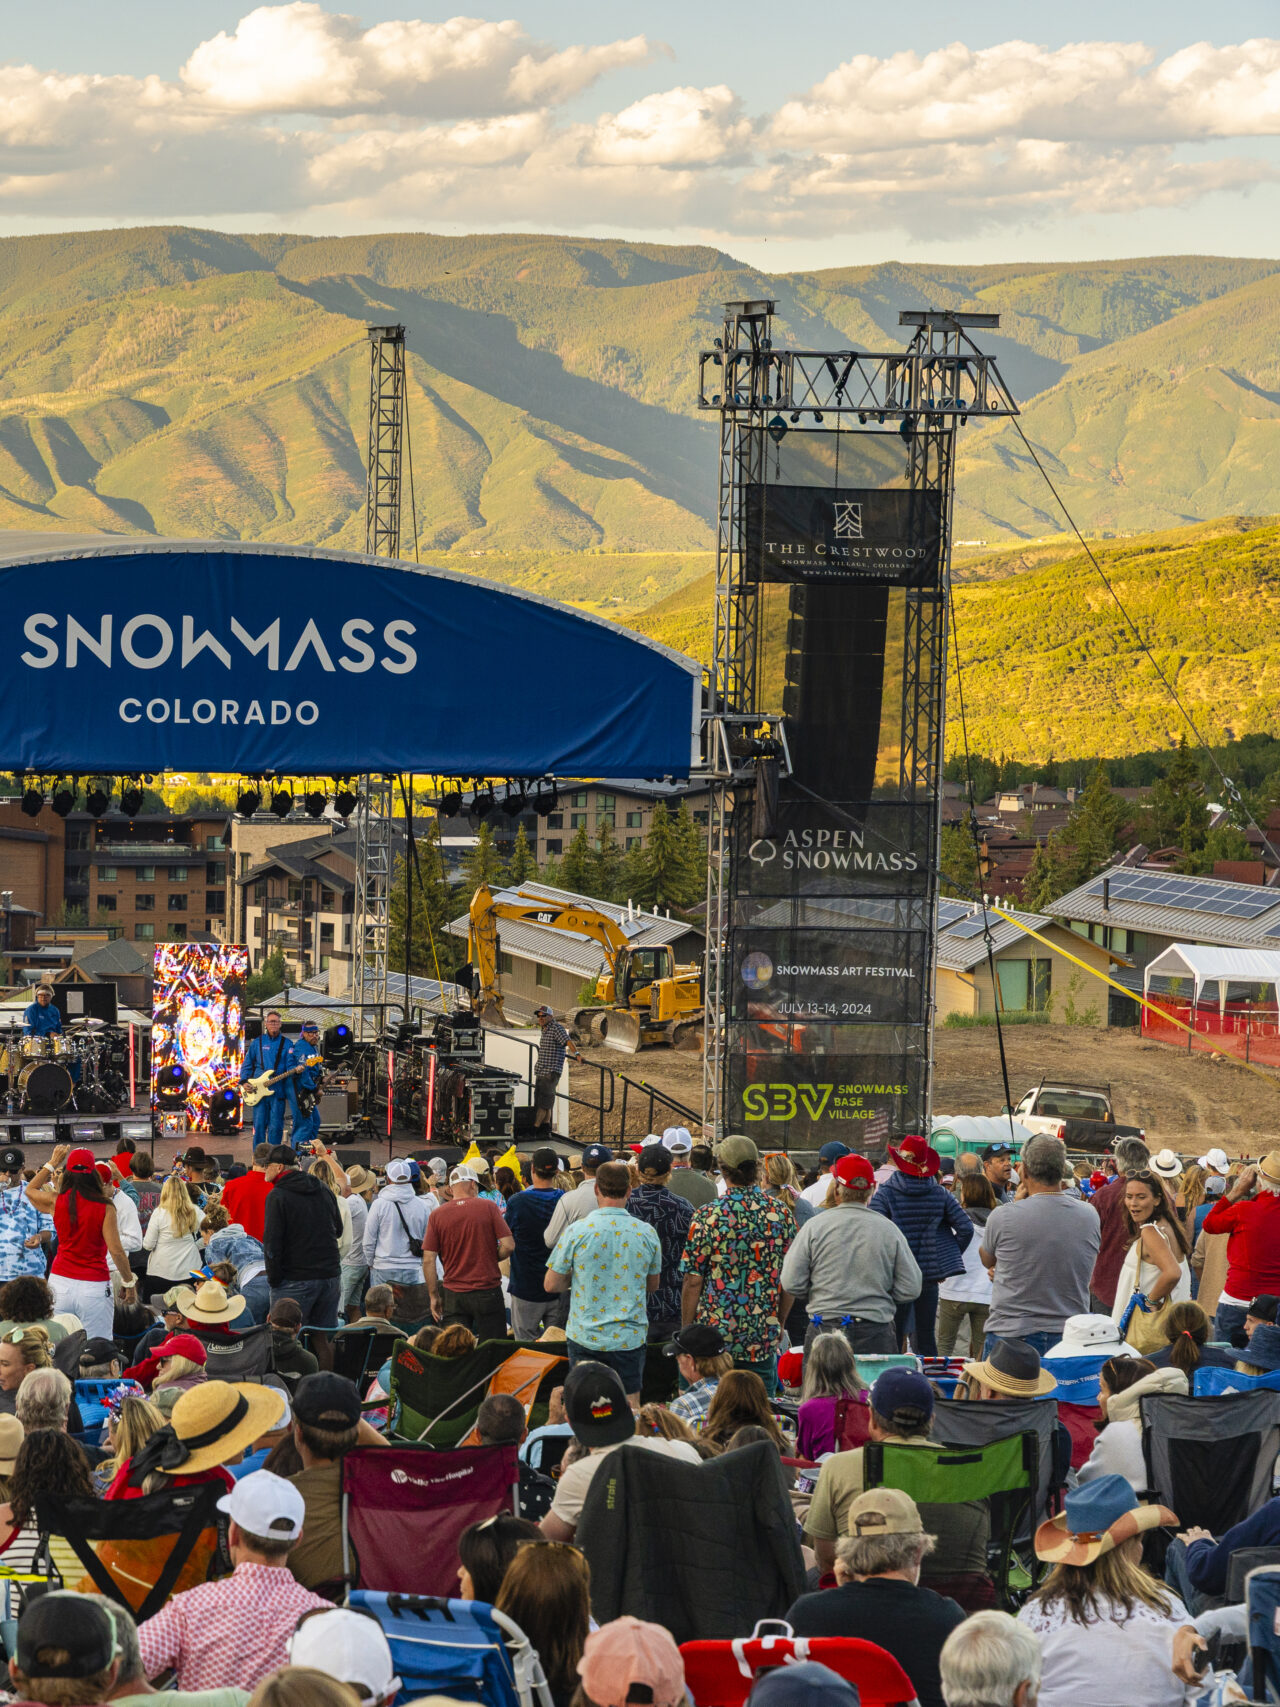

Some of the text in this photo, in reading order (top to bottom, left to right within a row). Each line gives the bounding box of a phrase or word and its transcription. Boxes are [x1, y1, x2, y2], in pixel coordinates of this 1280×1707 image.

[765, 542, 927, 559] THE CRESTWOOD
[20, 612, 418, 674] SNOWMASS
[118, 697, 320, 725] COLORADO
[783, 829, 864, 849] ASPEN
[783, 850, 918, 871] SNOWMASS
[537, 912, 553, 924] CAT
[776, 965, 916, 978] SNOWMASS ART FESTIVAL
[778, 1003, 872, 1016] JULY 13-14, 2024
[838, 1084, 909, 1094] SNOWMASS
[742, 1083, 834, 1121] SBV
[834, 1097, 863, 1107] BASE
[828, 1109, 876, 1120] VILLAGE
